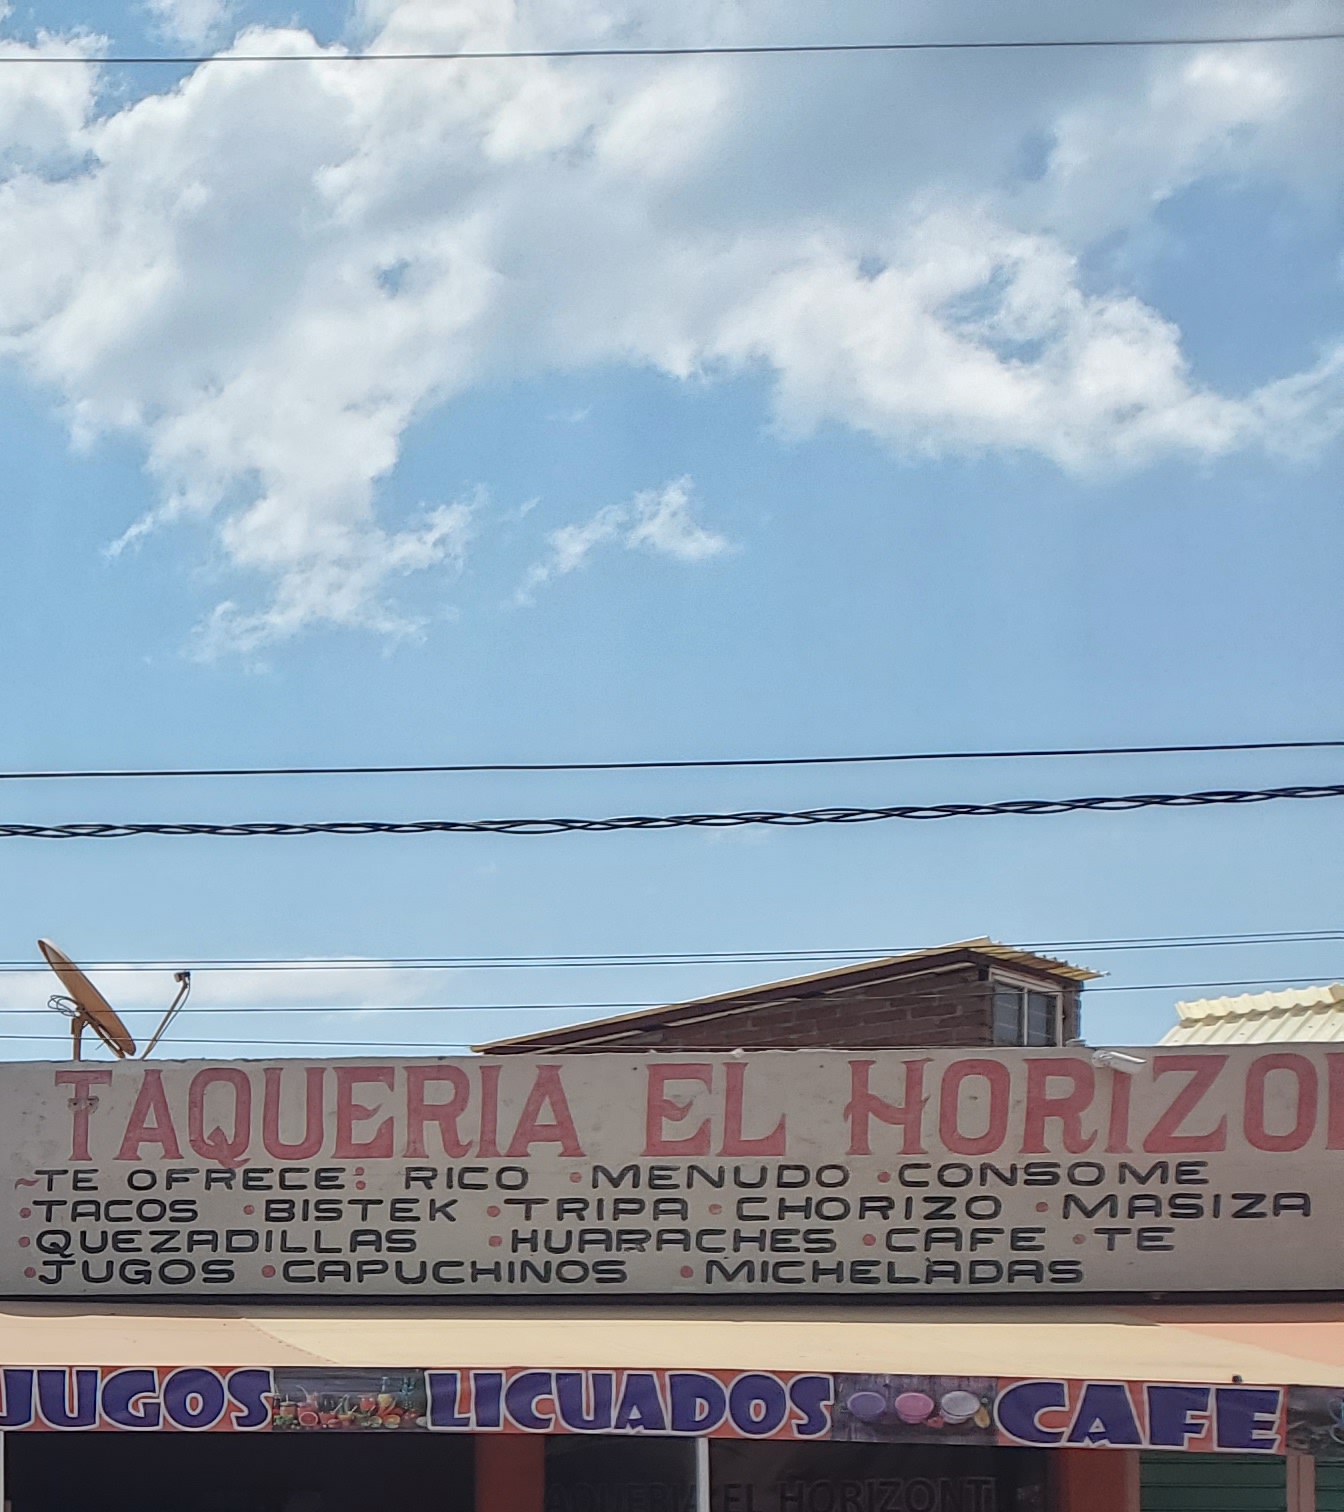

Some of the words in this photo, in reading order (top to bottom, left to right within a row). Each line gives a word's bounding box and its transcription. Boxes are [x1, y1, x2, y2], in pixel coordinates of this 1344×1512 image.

[55, 1065, 587, 1168] TAQUERIA
[640, 1062, 786, 1156] EL
[843, 1053, 1344, 1156] HORIZO
[33, 1168, 100, 1192] TE
[404, 1165, 529, 1191] RICO
[591, 1163, 850, 1190] MENUDO
[898, 1160, 1210, 1187] CONSOME
[31, 1198, 199, 1223] TACOS
[264, 1198, 458, 1223] BISTEK
[503, 1197, 689, 1222] TRIPA
[736, 1196, 1002, 1222] CHORIZO
[1062, 1191, 1311, 1219] MASIZA
[35, 1228, 418, 1258] QUEZADILLAS
[511, 1227, 837, 1254] HUARACHES
[885, 1226, 1047, 1252] CAFE
[1094, 1226, 1176, 1252] TE
[38, 1259, 236, 1285] JUGOS
[282, 1258, 628, 1285] CAPUCHINOS
[705, 1258, 1083, 1285] MICHELADAS
[423, 1370, 834, 1438] LICUADOS
[993, 1379, 1284, 1453] CAFE
